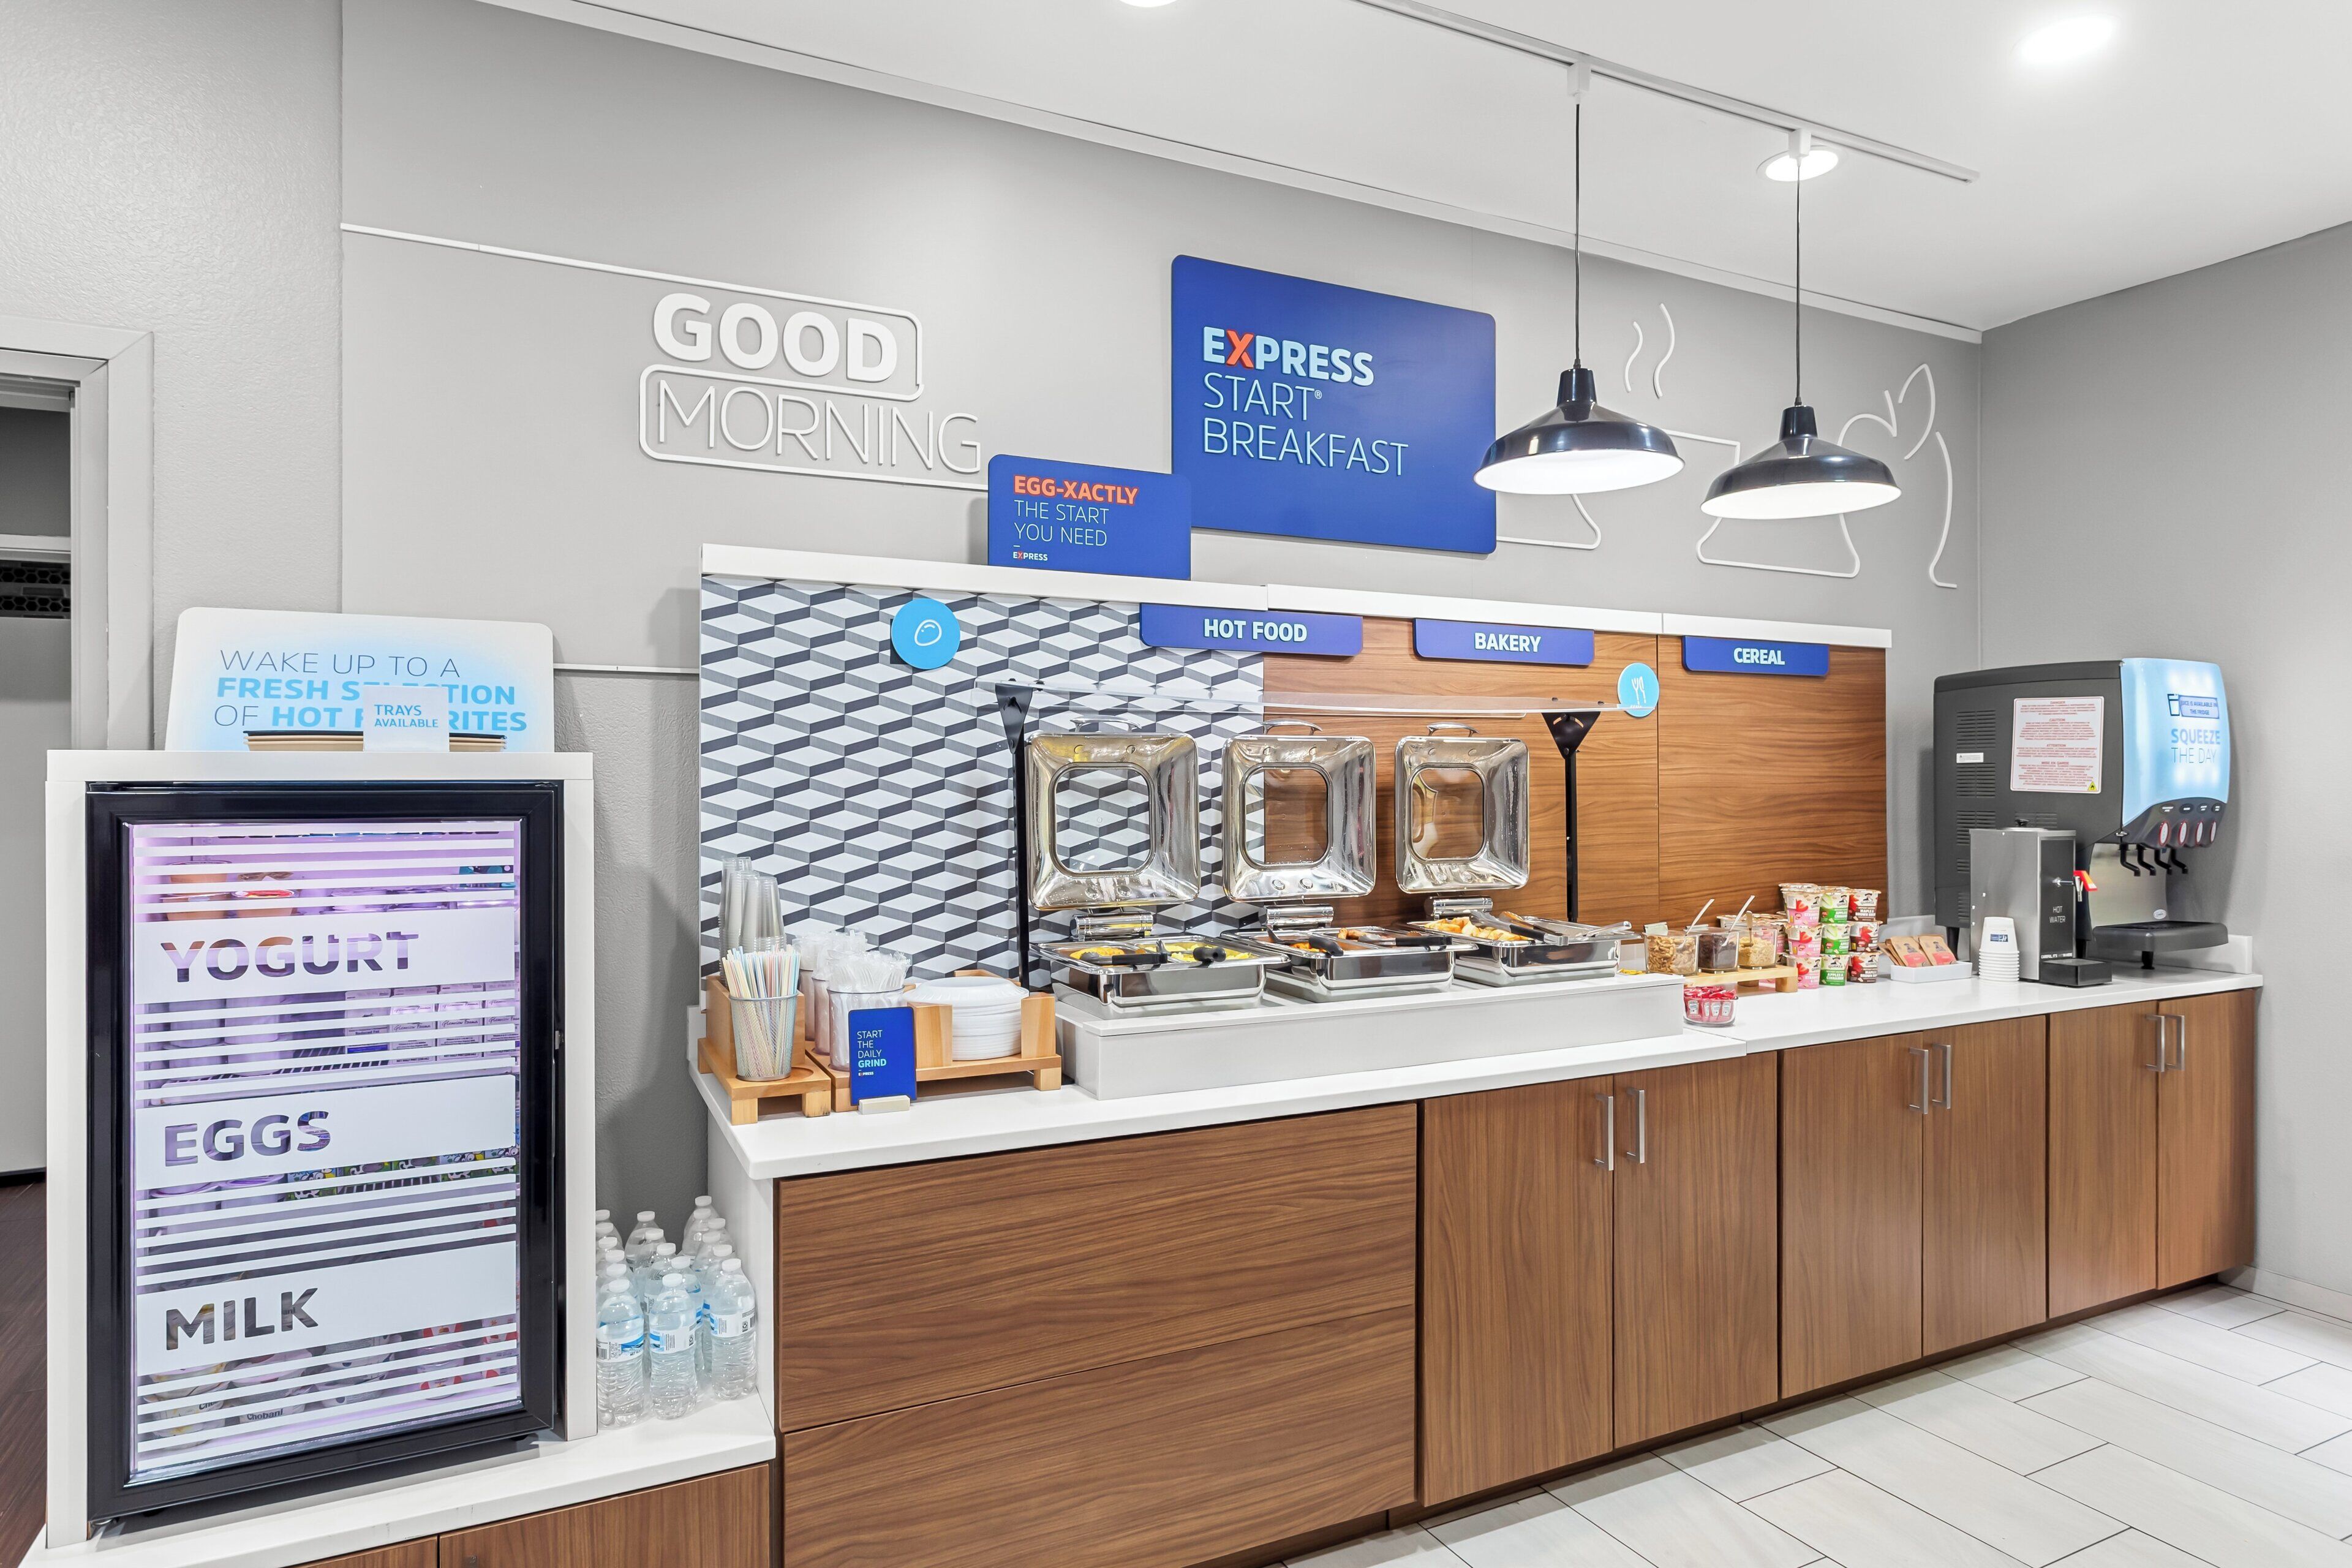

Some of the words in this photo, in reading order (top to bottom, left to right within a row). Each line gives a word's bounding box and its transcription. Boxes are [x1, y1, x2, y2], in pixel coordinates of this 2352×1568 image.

[654, 293, 897, 383] GOOD
[1203, 326, 1374, 386] EXPRESS
[658, 379, 981, 473] MORNING
[1204, 417, 1409, 476] BREAKFAST
[1014, 475, 1139, 505] EGG-XACTLY
[1014, 499, 1049, 519] THE
[1056, 503, 1109, 524] START
[1014, 522, 1053, 542] YOU
[1061, 526, 1107, 546] NEED
[1012, 551, 1048, 561] EXPRESS
[1204, 618, 1246, 639] HOT
[1252, 621, 1308, 642] FOOD
[1474, 632, 1542, 652] BAKERY
[220, 649, 318, 673] WAKE
[333, 654, 375, 674] UP
[388, 655, 428, 677] TO
[440, 658, 460, 677] A
[1733, 647, 1785, 666] CEREAL
[217, 677, 328, 700] FRESH
[341, 680, 515, 705] STION
[214, 705, 259, 726] OF
[271, 706, 342, 728] HOT
[374, 704, 422, 716] TRAYS
[374, 718, 439, 728] AVAILABLE
[2171, 728, 2220, 745] SQUEEZE
[2171, 747, 2194, 763] THE
[2198, 748, 2217, 763] DAY
[160, 931, 419, 983] YOGURT
[857, 1030, 883, 1039] START
[858, 1040, 874, 1049] THE
[858, 1049, 882, 1059] DAILY
[858, 1058, 887, 1068] GRIND
[165, 1110, 331, 1167] EGGS
[165, 1287, 318, 1351] MILK
[246, 1408, 284, 1420] Chobani
